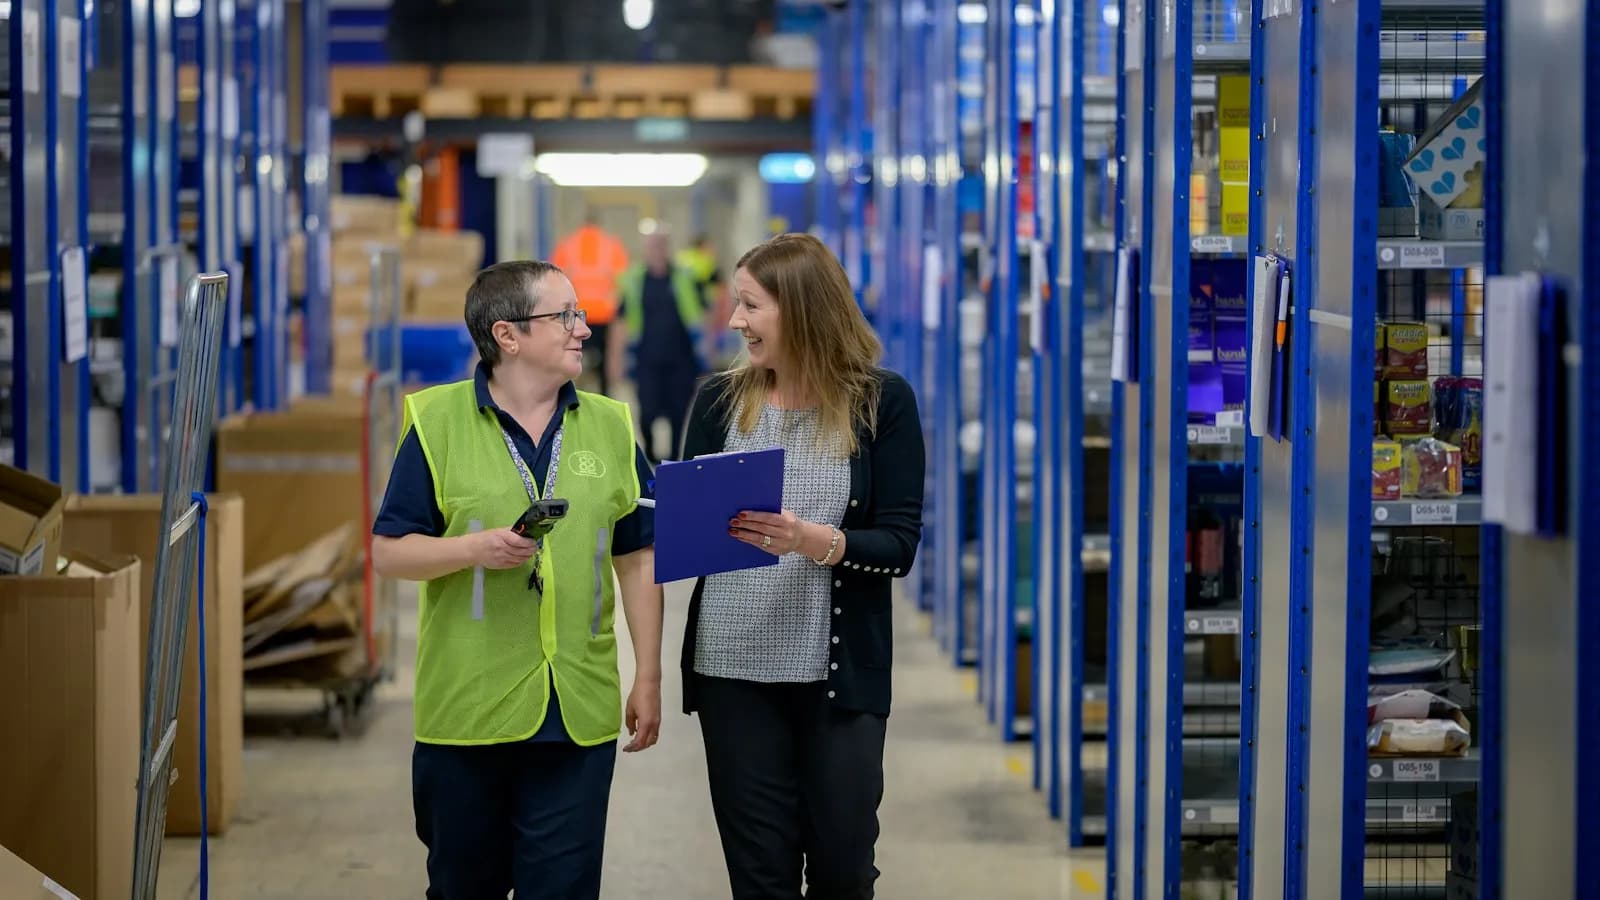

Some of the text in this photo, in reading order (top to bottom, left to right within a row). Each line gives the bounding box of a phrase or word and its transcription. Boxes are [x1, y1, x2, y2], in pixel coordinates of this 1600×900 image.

[1403, 247, 1439, 256] D05-050
[1416, 505, 1450, 514] D05-100
[1399, 763, 1433, 772] D05-150
